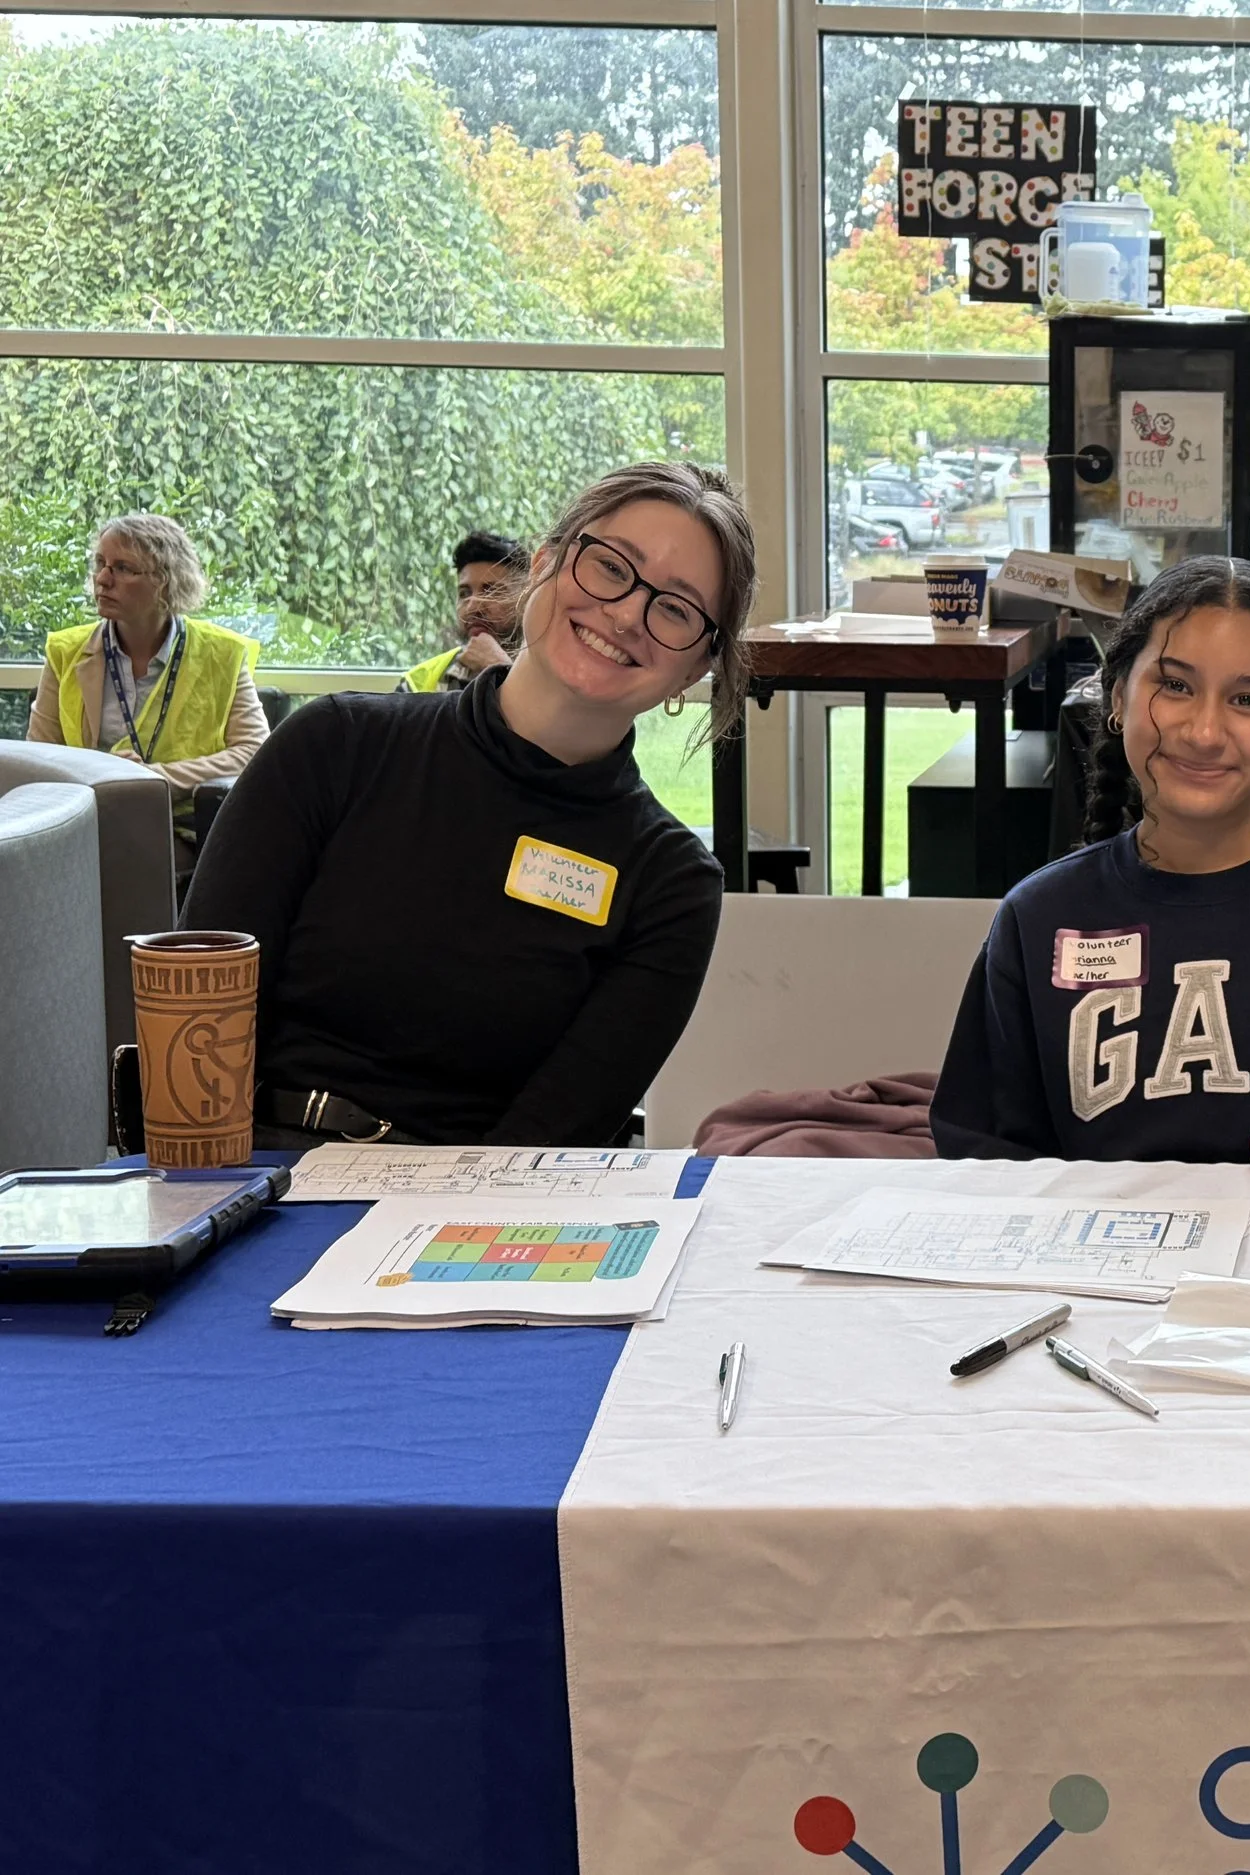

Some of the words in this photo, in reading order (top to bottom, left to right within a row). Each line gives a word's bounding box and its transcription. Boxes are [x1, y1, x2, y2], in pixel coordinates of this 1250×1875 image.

[904, 106, 1066, 163] TEEN
[901, 169, 1094, 228] FORCE
[1127, 490, 1178, 512] Cherry
[928, 598, 978, 612] ONUTS
[1070, 937, 1132, 950] olunteer
[1073, 955, 1116, 965] rianna
